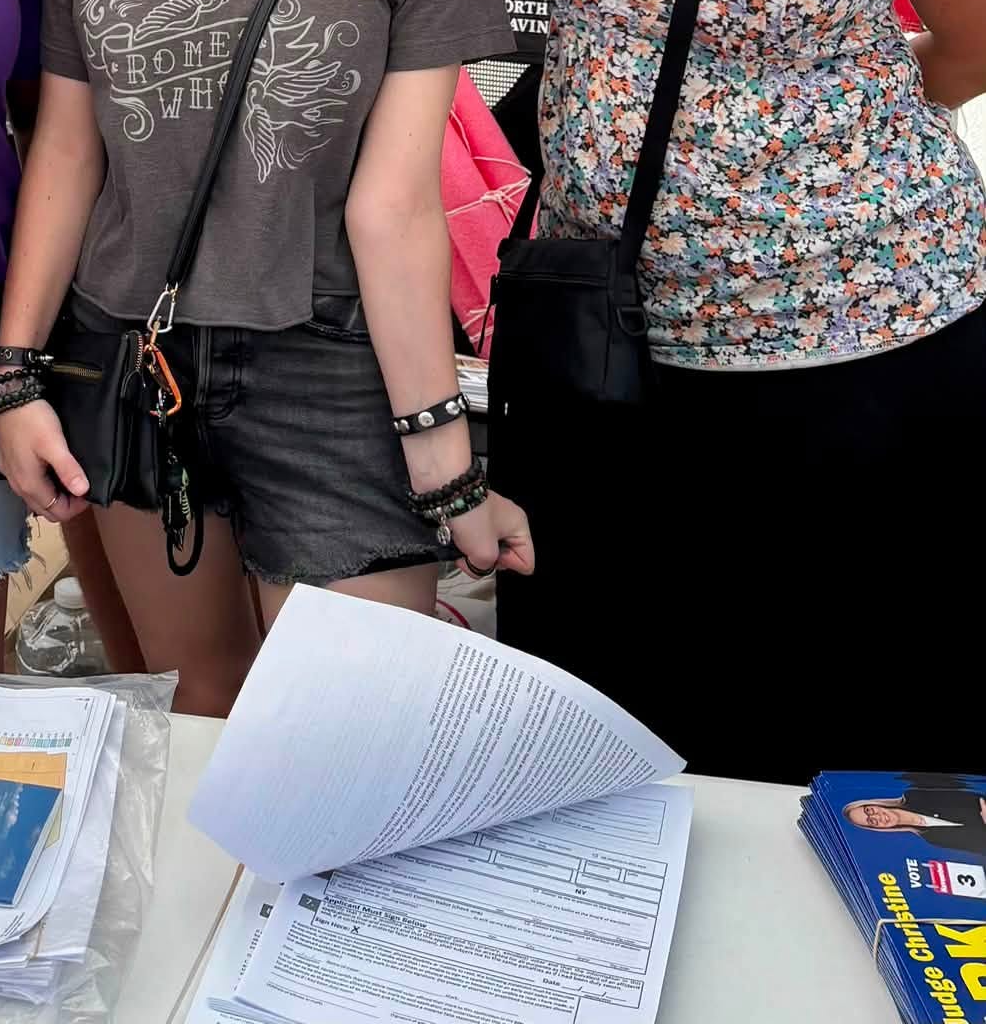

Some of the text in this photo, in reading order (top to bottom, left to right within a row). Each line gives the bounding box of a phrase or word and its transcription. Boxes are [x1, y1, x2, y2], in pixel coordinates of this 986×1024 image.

[504, 0, 549, 16] ORTH
[510, 17, 549, 34] AVIN
[125, 29, 245, 85] ROME
[906, 858, 922, 888] VOTE
[957, 873, 976, 887] 3
[324, 895, 361, 910] Applicant
[362, 906, 383, 916] Must
[384, 911, 401, 921] Sign
[401, 916, 427, 928] Below
[877, 872, 935, 963] Christine
